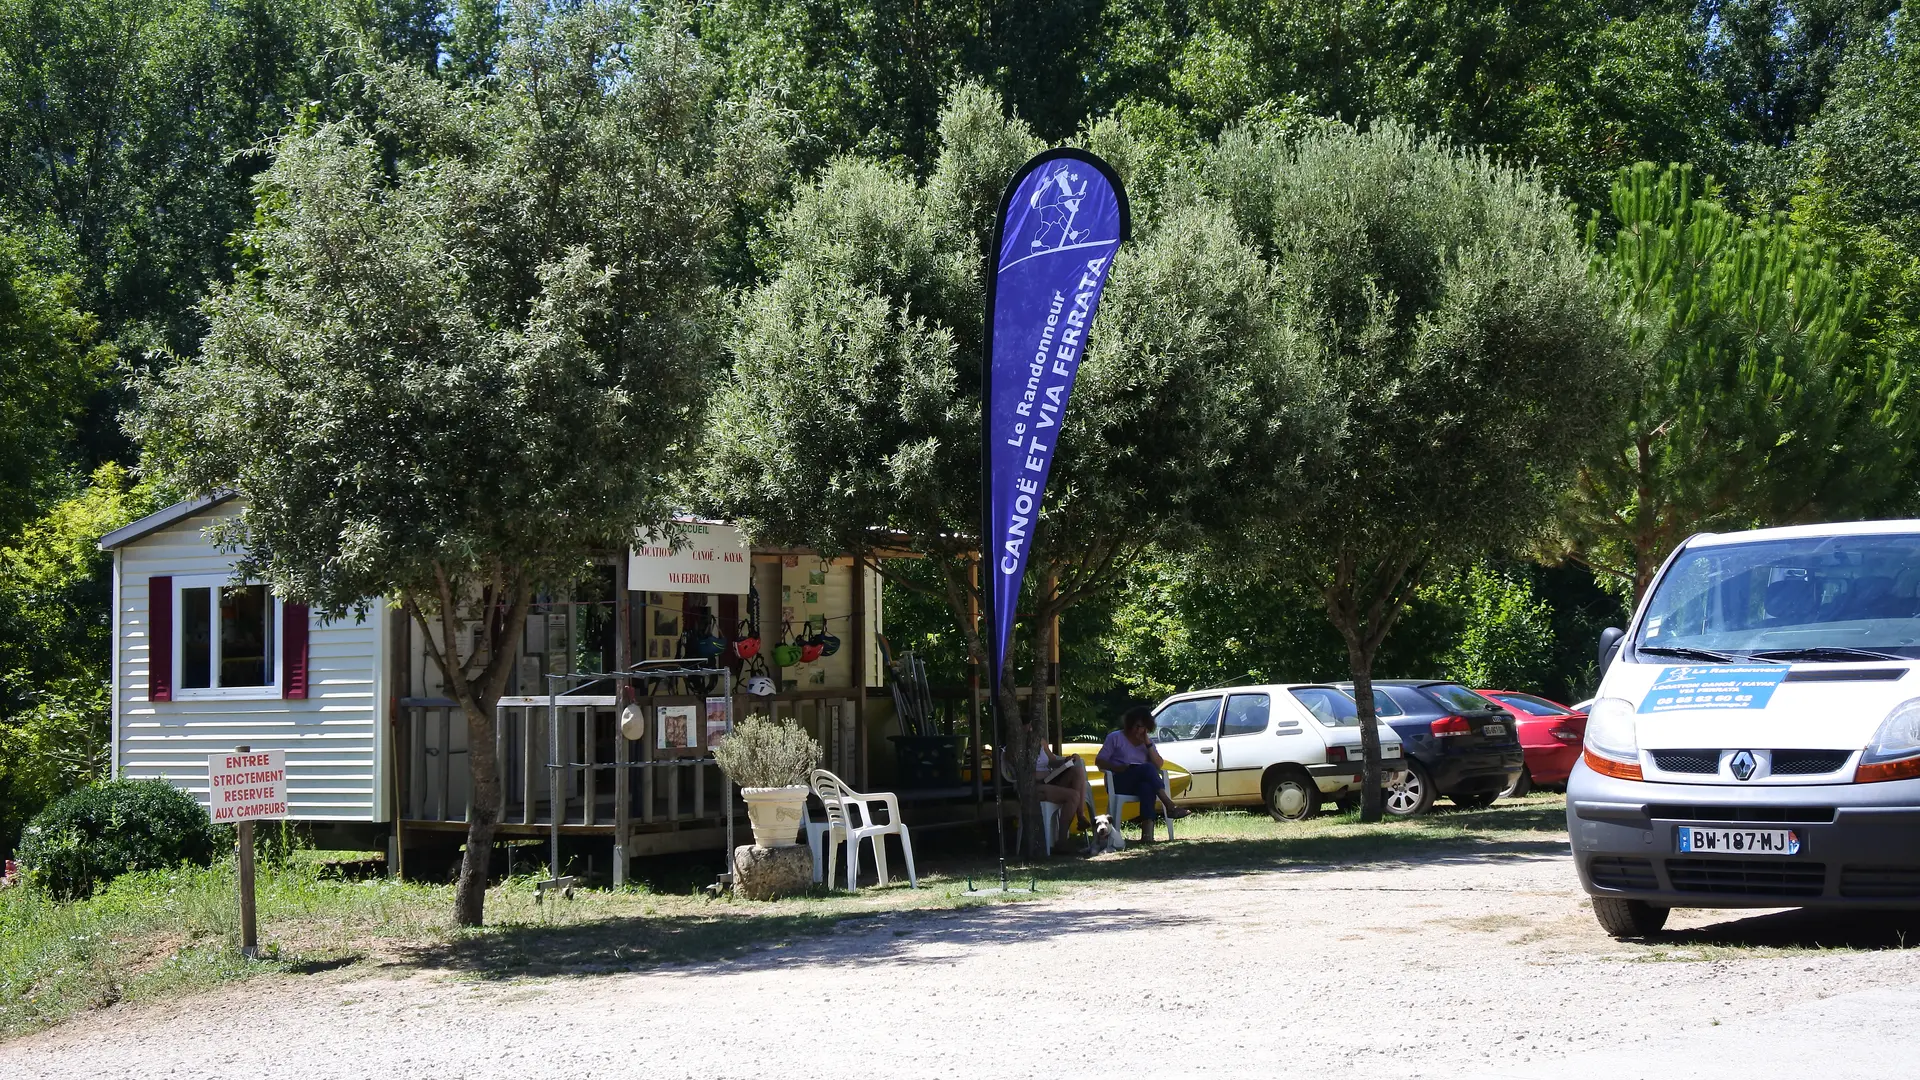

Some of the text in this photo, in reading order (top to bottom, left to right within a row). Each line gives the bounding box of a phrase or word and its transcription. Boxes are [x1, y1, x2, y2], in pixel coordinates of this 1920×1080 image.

[1007, 290, 1066, 448] Le Randonneur
[1000, 256, 1108, 575] CANOË ET VIA FERRATA
[677, 523, 709, 535] ACCUEIL
[637, 546, 743, 563] OCATION CANOË KAYAK
[669, 573, 710, 584] VIA FERRATA
[226, 754, 270, 768] ENTREE
[213, 770, 283, 787] STRICTEMENT
[224, 787, 275, 802] RESERVEE
[215, 802, 286, 820] AUX CAMPEURS
[1693, 831, 1785, 851] BW-187-MJ
